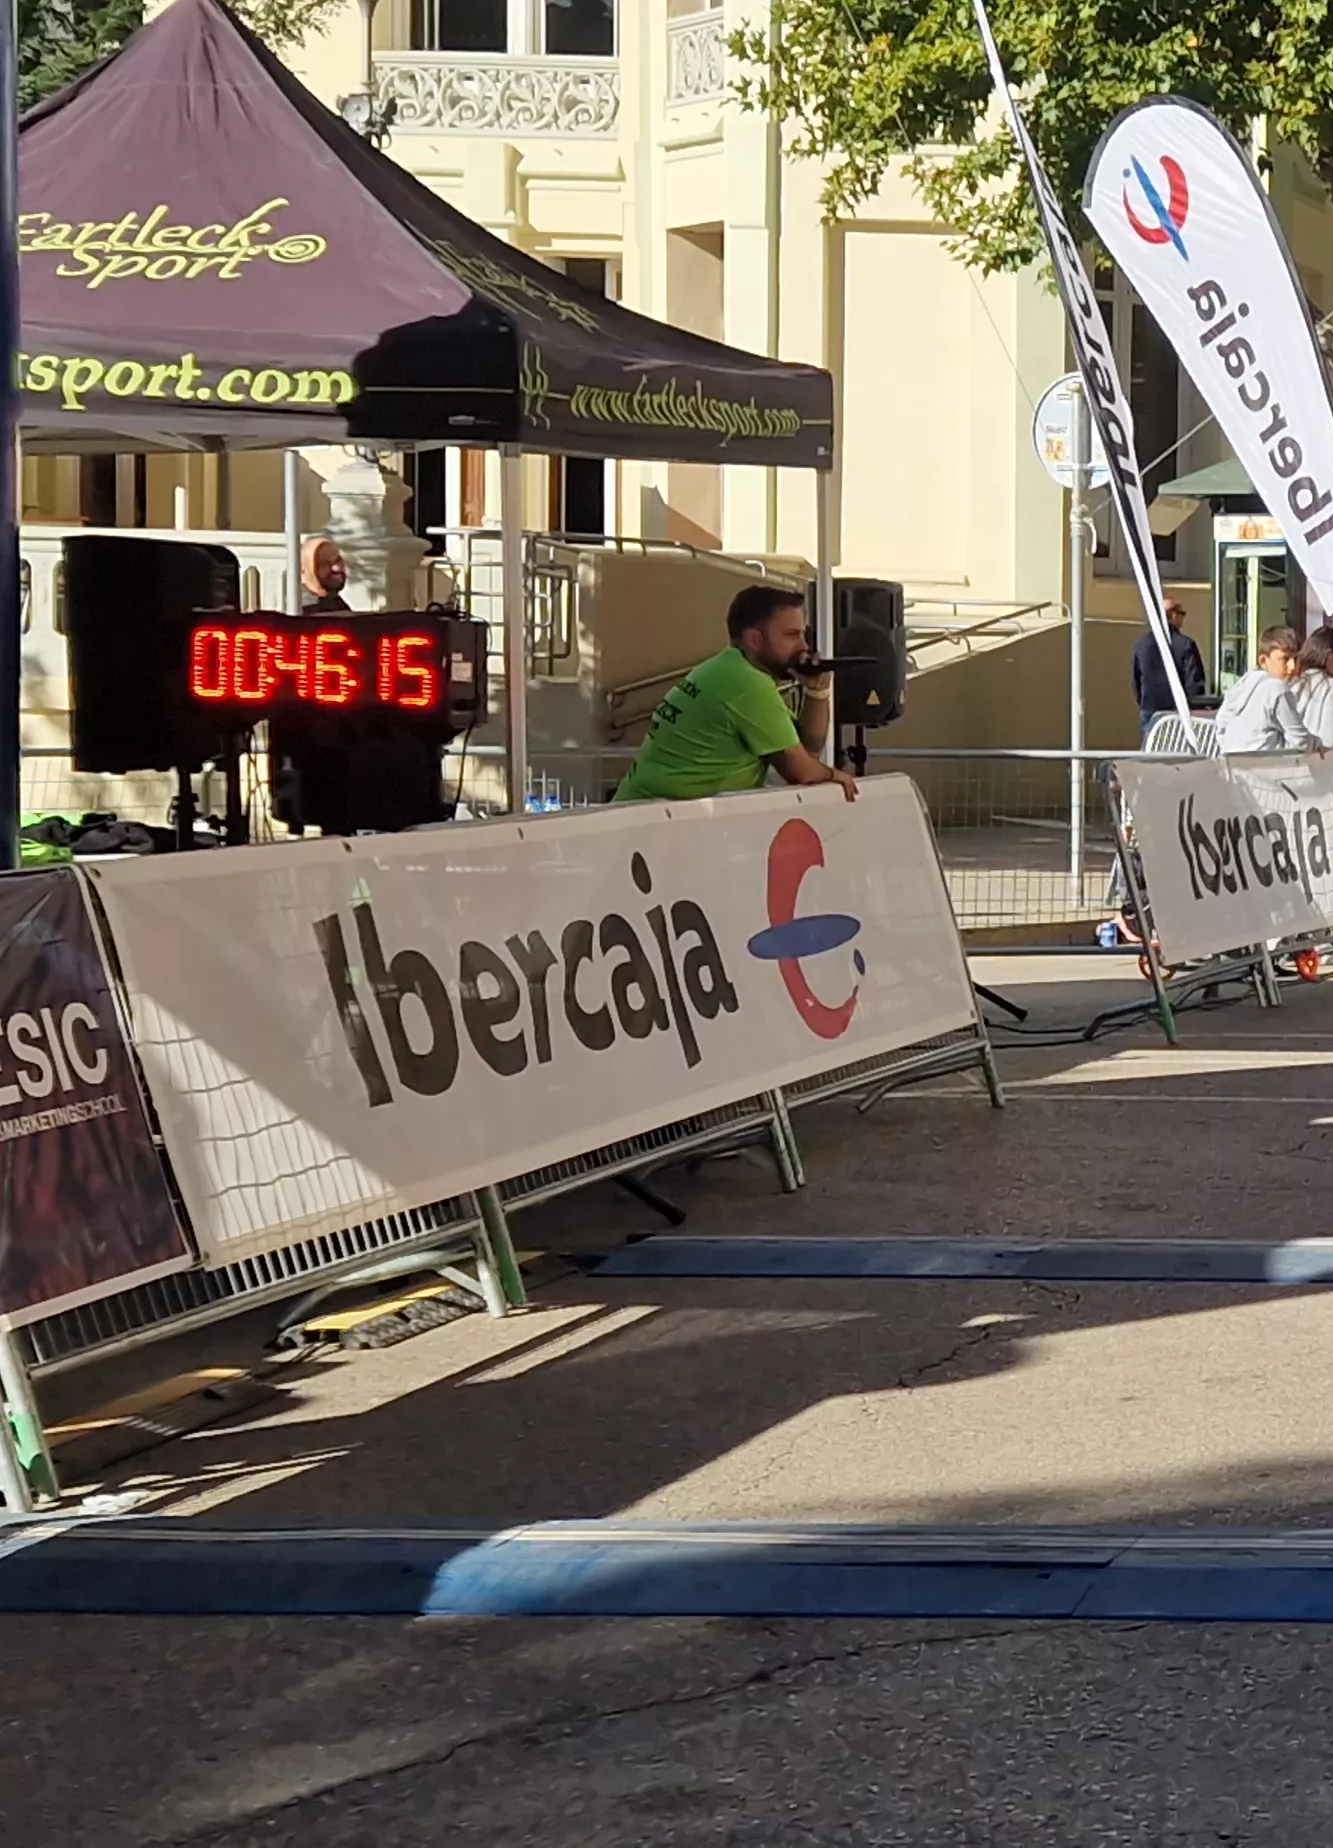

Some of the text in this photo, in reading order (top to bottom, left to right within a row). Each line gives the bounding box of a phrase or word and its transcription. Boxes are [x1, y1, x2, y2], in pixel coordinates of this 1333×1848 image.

[56, 242, 251, 289] Sport
[1178, 780, 1332, 903] Ibercaja
[312, 851, 739, 1108] Ibercaja
